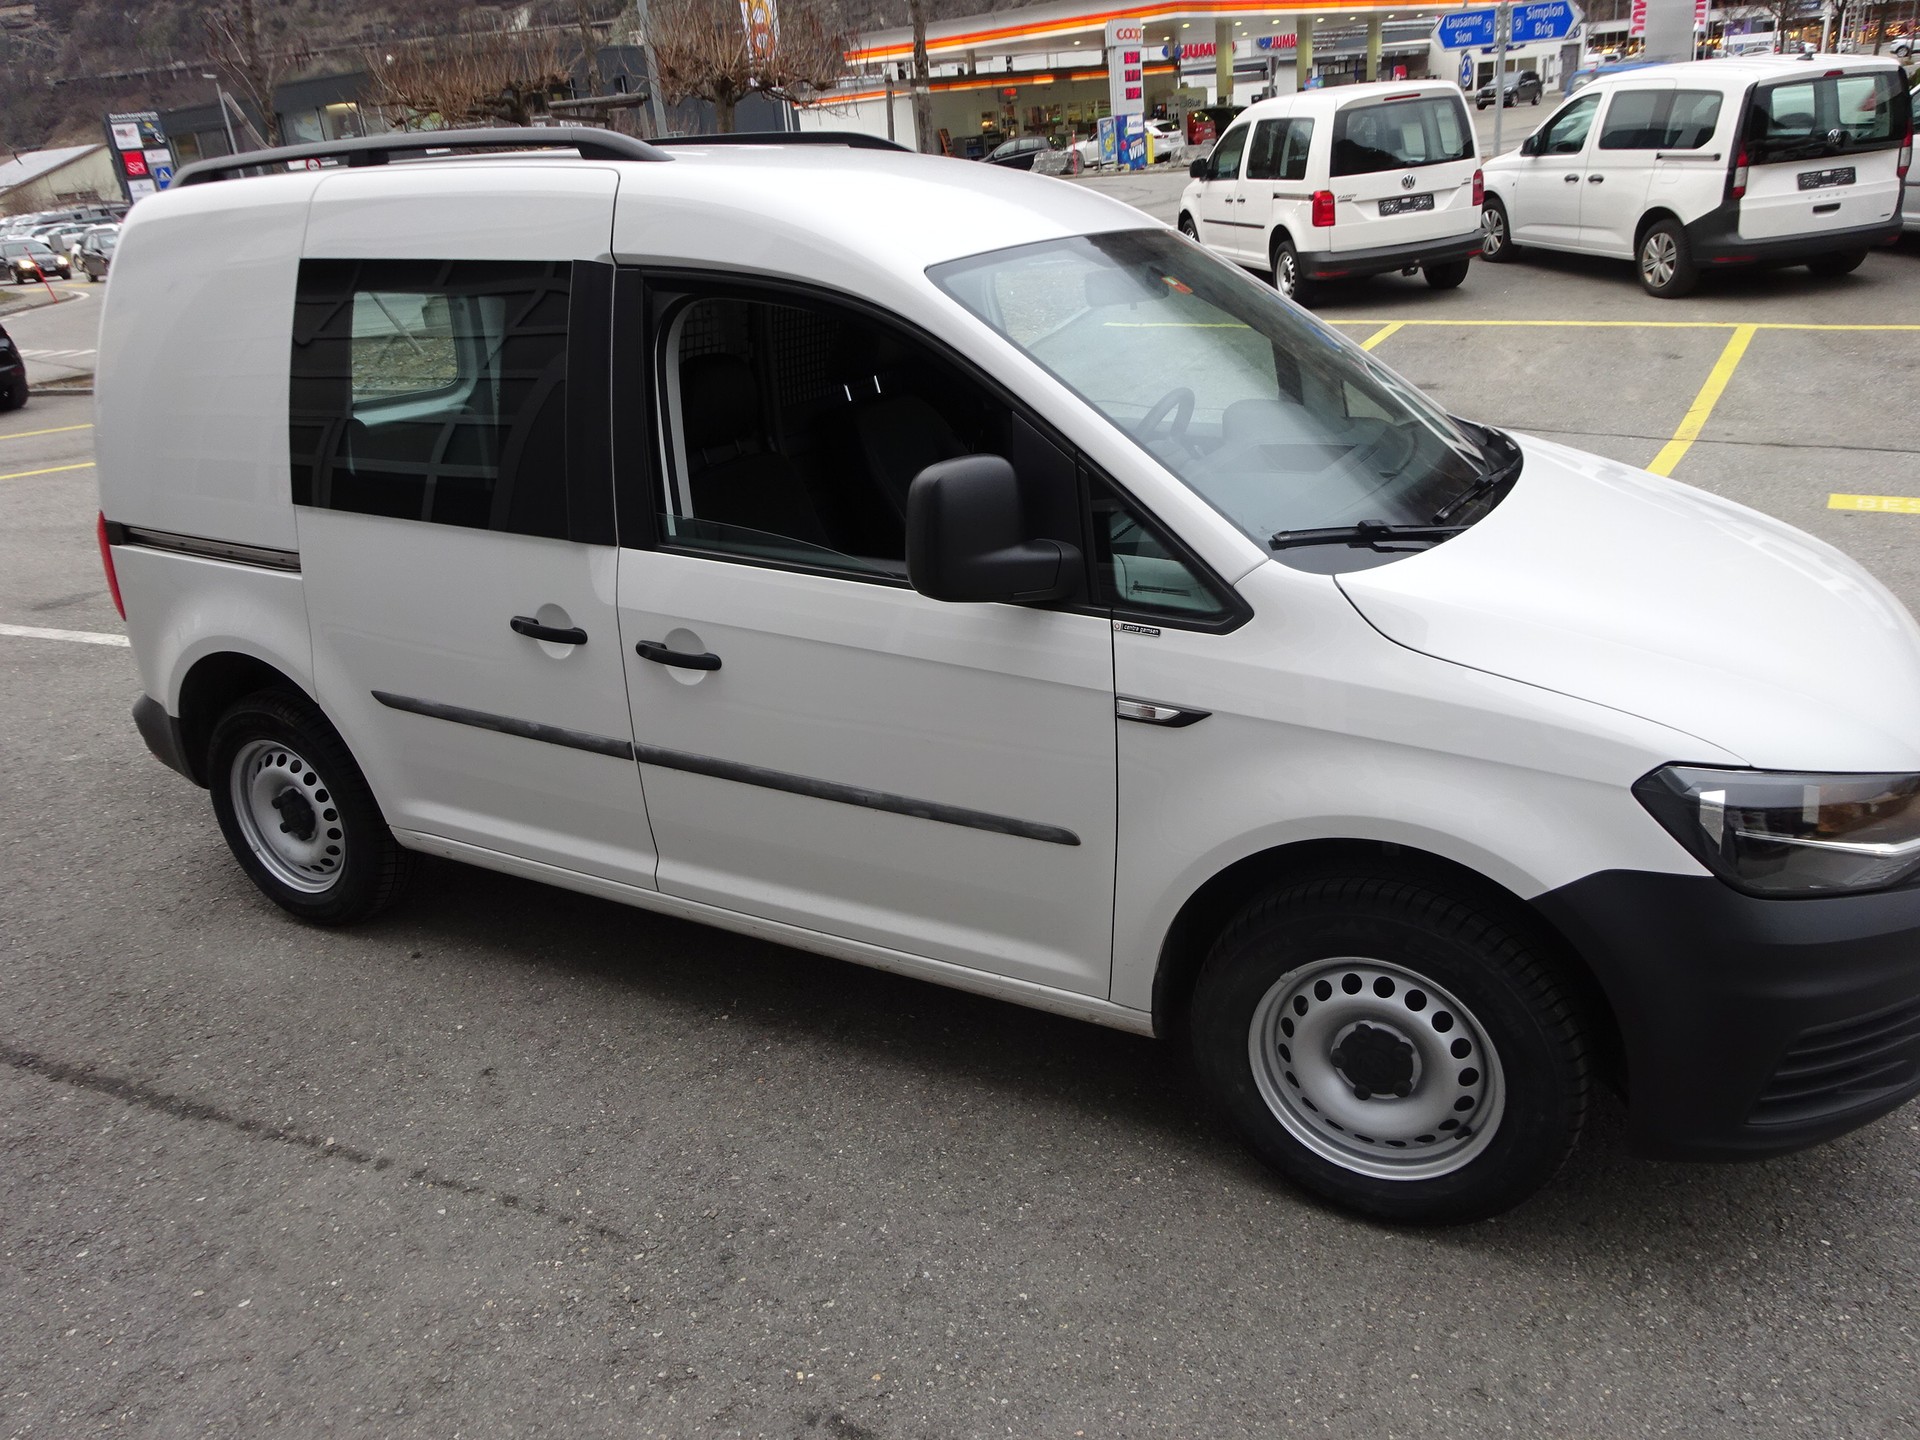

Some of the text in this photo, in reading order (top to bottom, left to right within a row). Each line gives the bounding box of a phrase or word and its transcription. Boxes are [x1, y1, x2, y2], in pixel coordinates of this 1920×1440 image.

[1526, 4, 1564, 21] Simplon
[1446, 14, 1483, 29] Lausanne
[1485, 19, 1492, 33] 9
[1514, 18, 1522, 31] 9
[1116, 27, 1142, 42] coop
[1534, 22, 1554, 37] Brig
[1454, 31, 1472, 44] Sion
[1129, 143, 1145, 160] WIN
